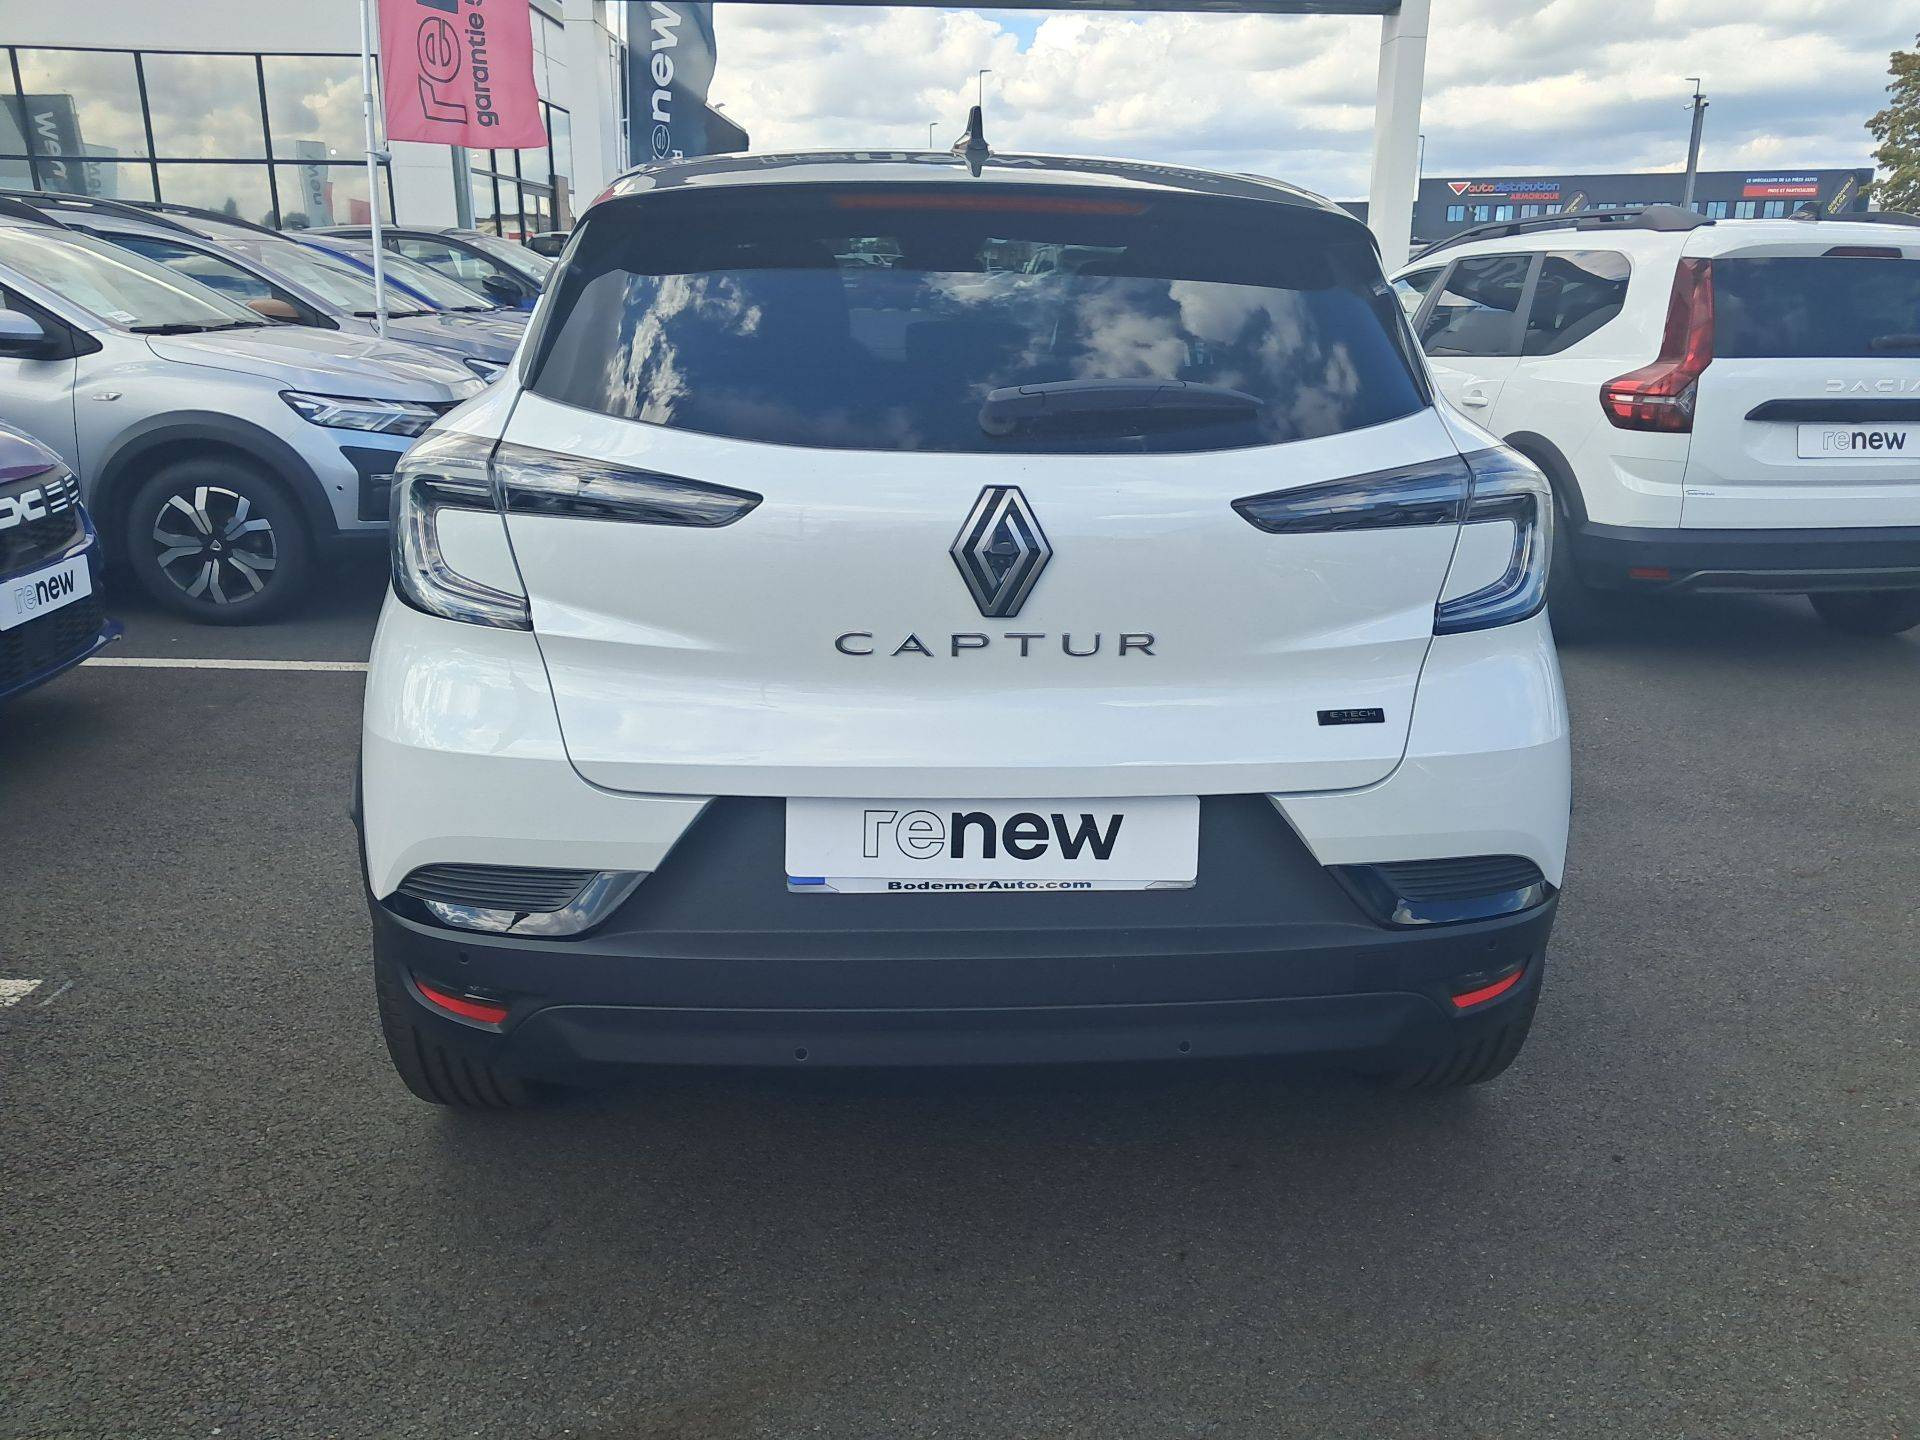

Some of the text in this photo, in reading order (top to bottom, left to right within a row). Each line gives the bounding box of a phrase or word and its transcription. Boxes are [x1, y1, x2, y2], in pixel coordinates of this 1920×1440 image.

[465, 12, 499, 127] garantie
[650, 2, 682, 160] enew
[1822, 431, 1907, 451] renew
[13, 568, 75, 615] renew
[834, 631, 1157, 657] CAPTUR
[1329, 710, 1377, 718] E-TECH
[862, 809, 1125, 860] renew
[887, 880, 1092, 890] BodemerAuto.com
